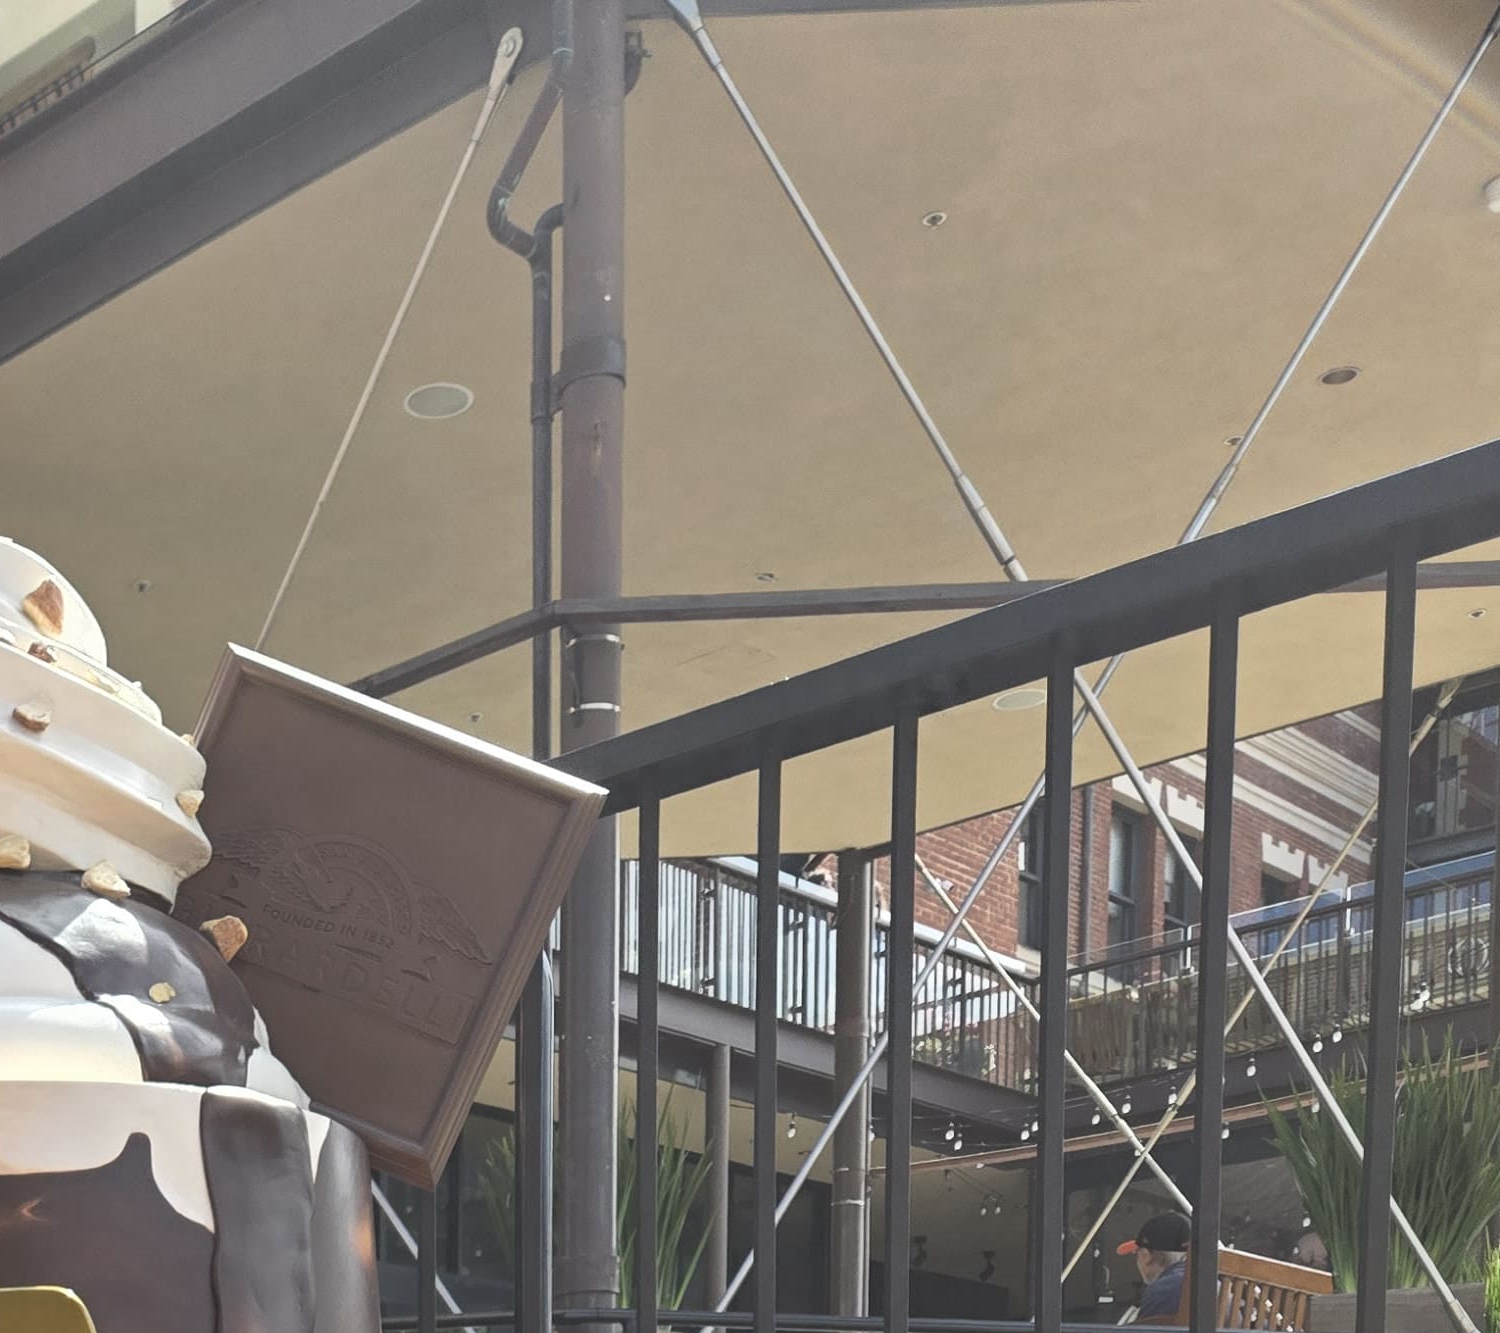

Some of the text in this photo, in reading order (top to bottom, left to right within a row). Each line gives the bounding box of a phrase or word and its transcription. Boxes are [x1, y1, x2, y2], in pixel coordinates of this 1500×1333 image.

[262, 903, 395, 949] FOUNDED IN 1852
